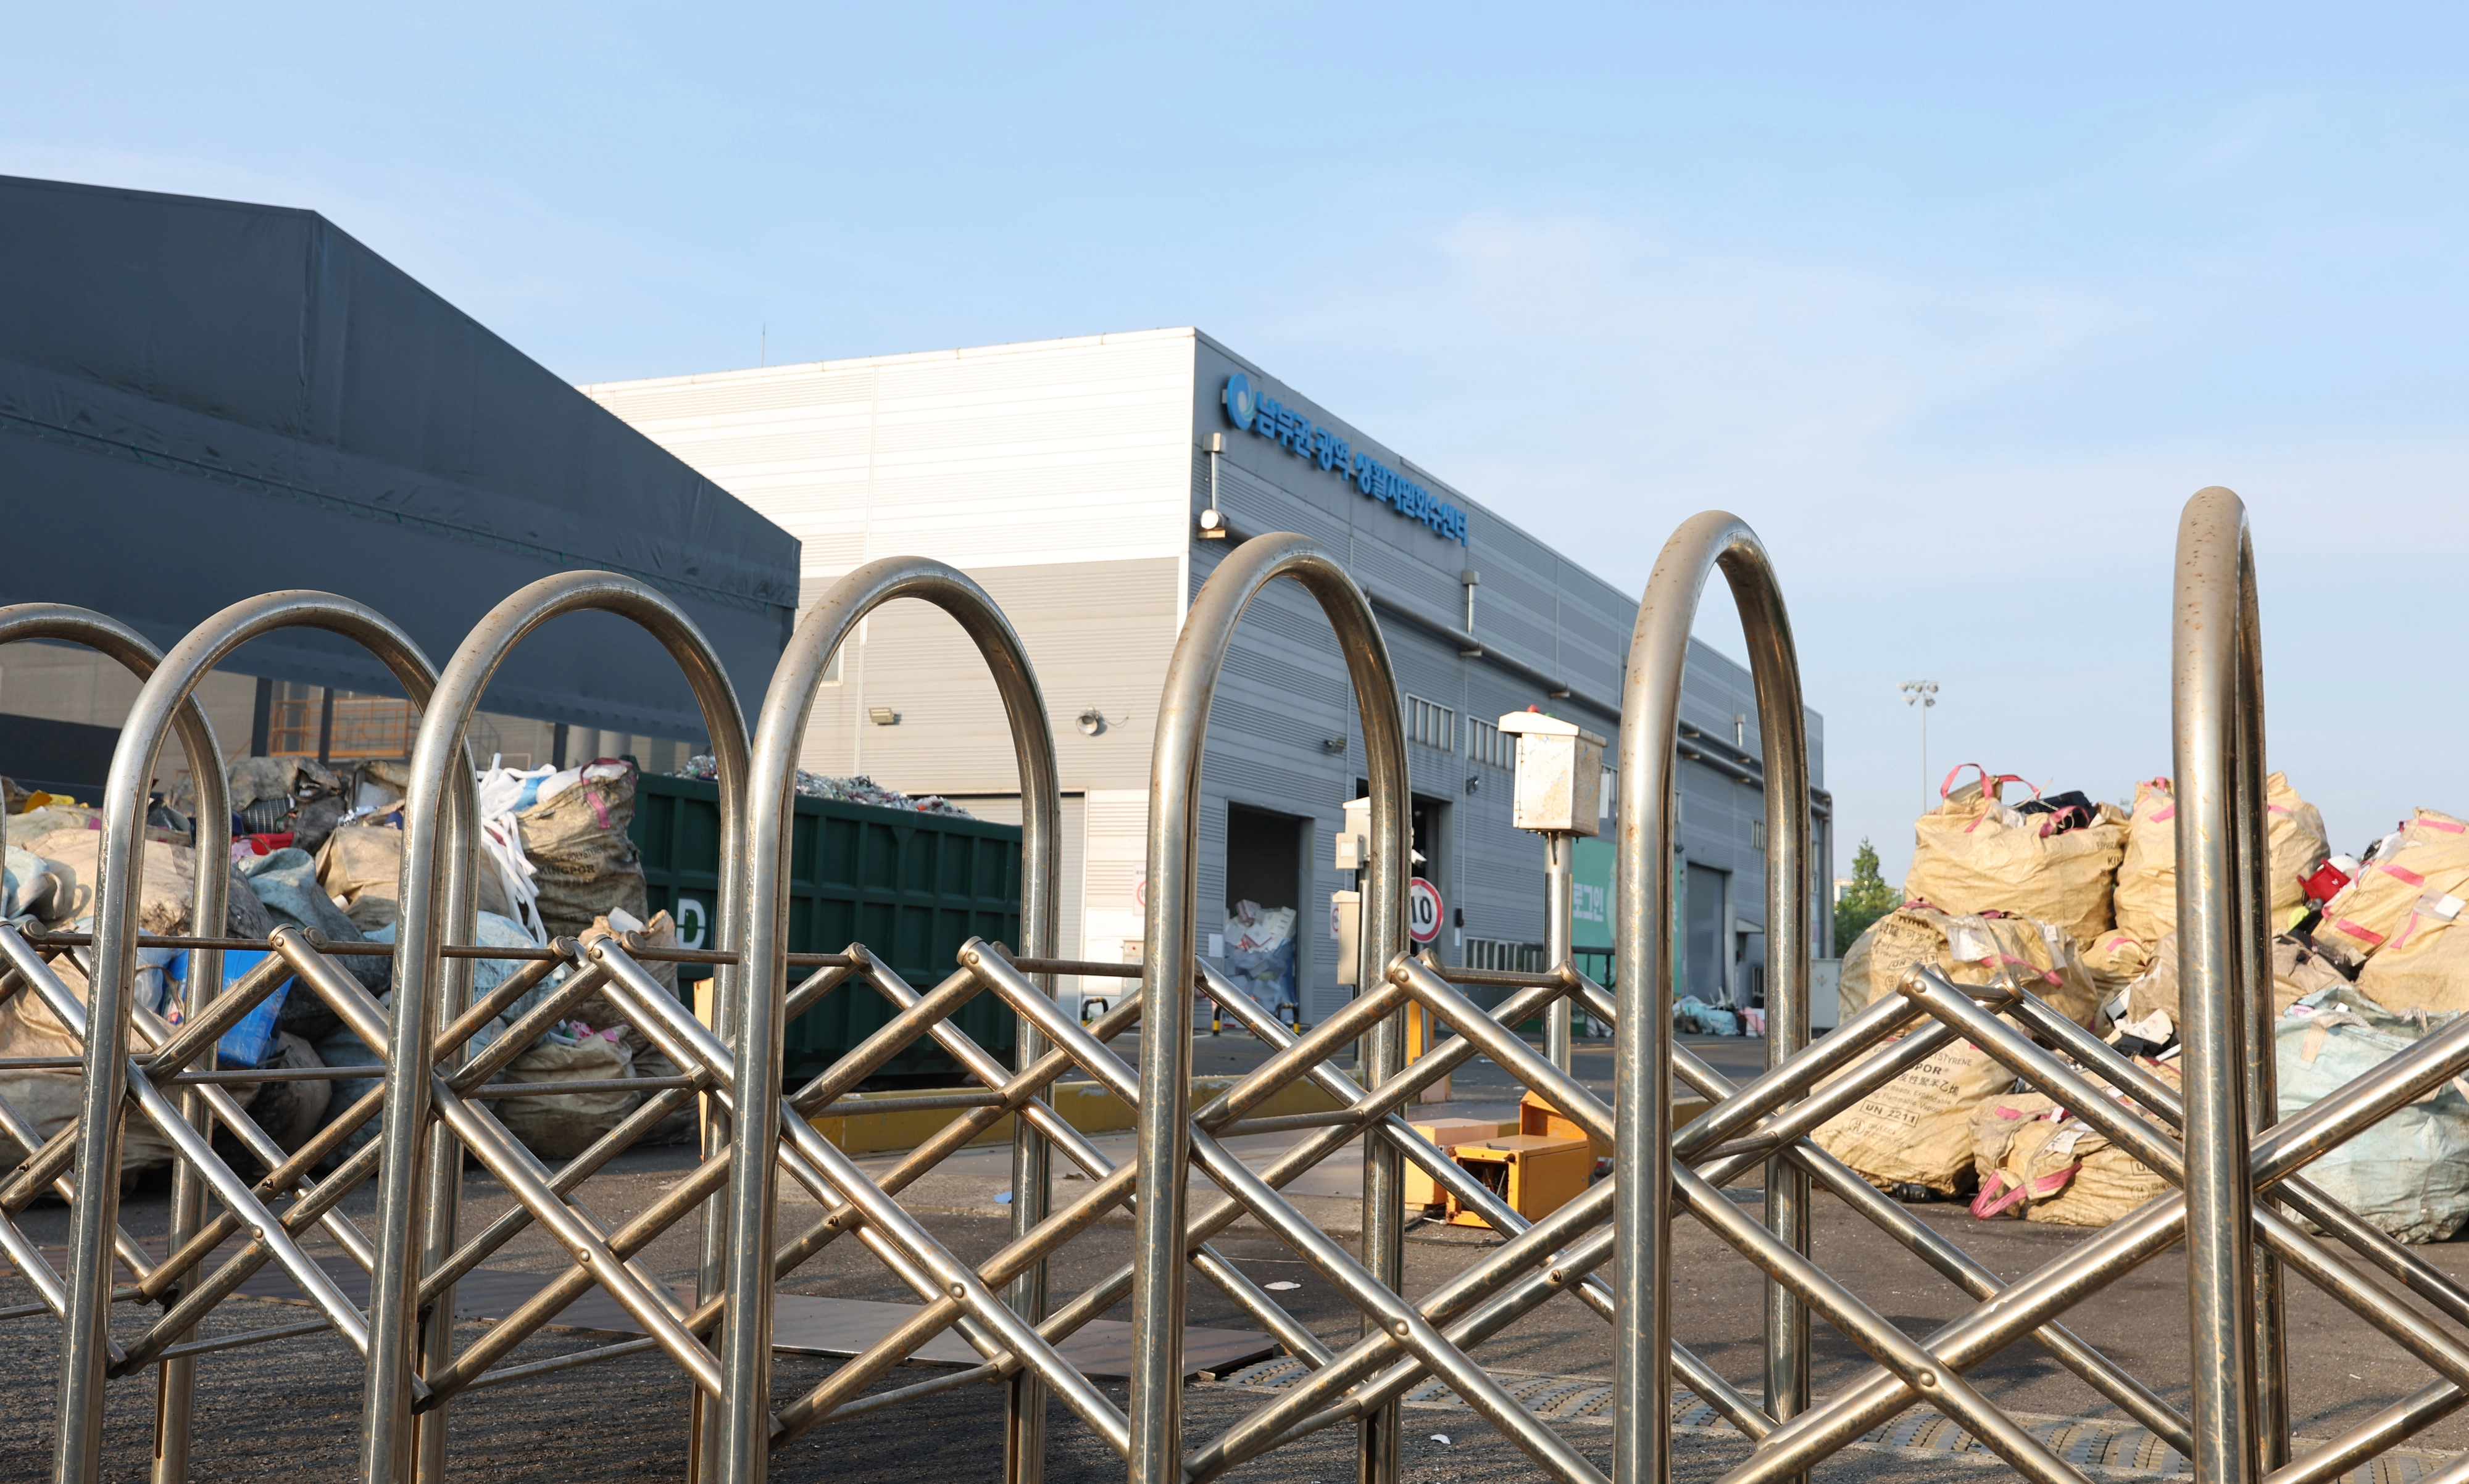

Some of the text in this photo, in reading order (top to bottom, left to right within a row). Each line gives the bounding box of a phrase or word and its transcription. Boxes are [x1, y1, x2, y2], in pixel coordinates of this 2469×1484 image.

[1255, 391, 1468, 547] 남부권 광역 생활자원회수센터
[1410, 896, 1432, 924] 10
[1572, 882, 1604, 922] 로그인
[676, 898, 706, 950] D
[1930, 1051, 1973, 1067] YSTYRENE
[1898, 1072, 1960, 1096] 发性聚苯乙烯
[1865, 1103, 1915, 1123] UN 2211
